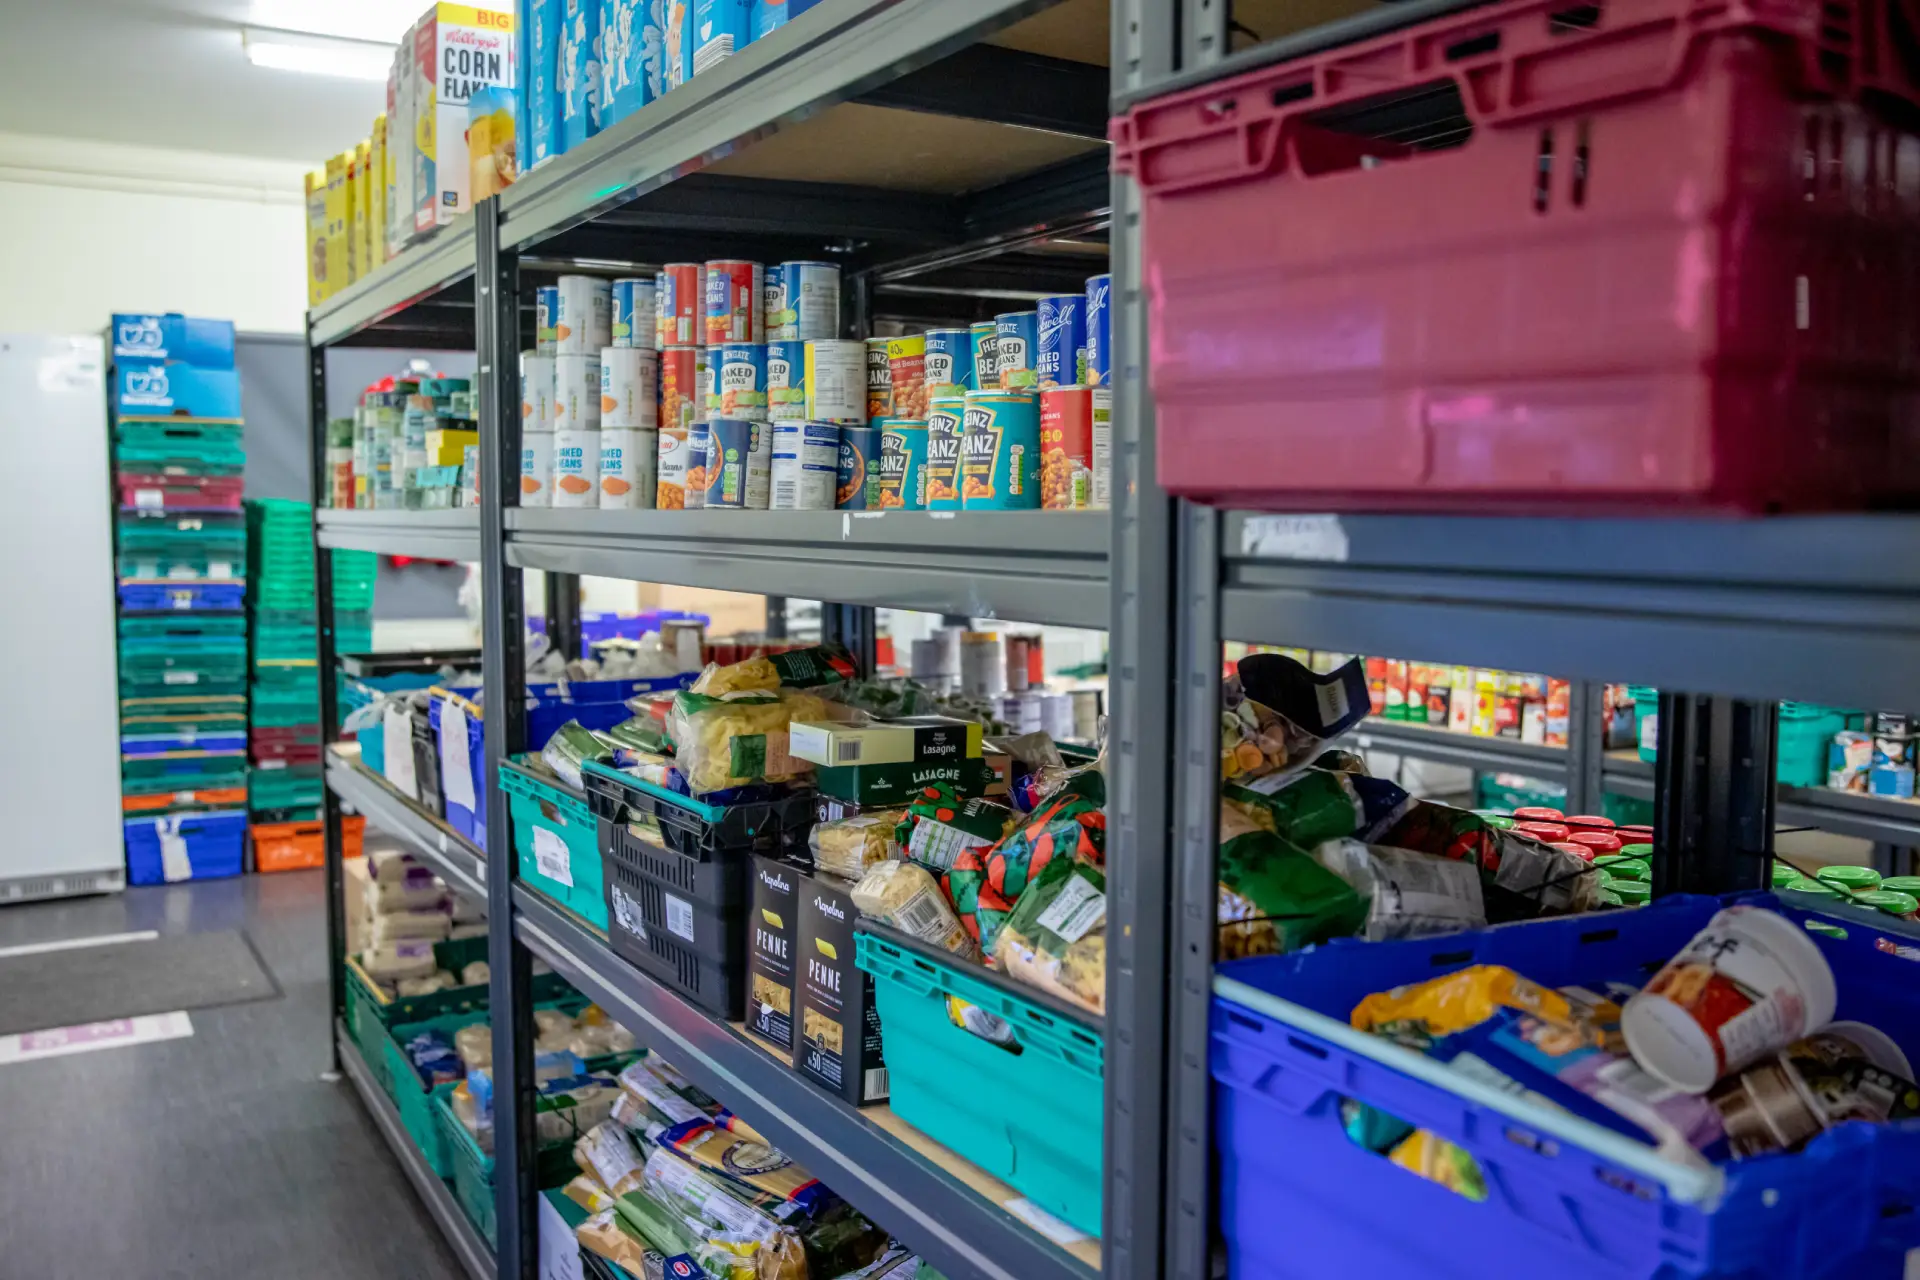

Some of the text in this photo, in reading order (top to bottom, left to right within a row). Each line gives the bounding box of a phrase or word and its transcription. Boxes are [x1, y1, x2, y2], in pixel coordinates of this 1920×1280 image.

[477, 10, 509, 28] BIG
[444, 47, 500, 80] CORN
[868, 351, 888, 364] EINZ
[929, 417, 953, 433] EINZ
[965, 411, 988, 428] EINZ
[882, 436, 900, 450] EINZ
[928, 439, 958, 458] EANZ
[963, 434, 994, 454] EANZ
[880, 456, 904, 472] EANZ
[923, 745, 957, 755] Lasagne
[912, 768, 960, 784] LASAGNE
[756, 928, 788, 959] PENNE
[808, 958, 842, 992] PENNE
